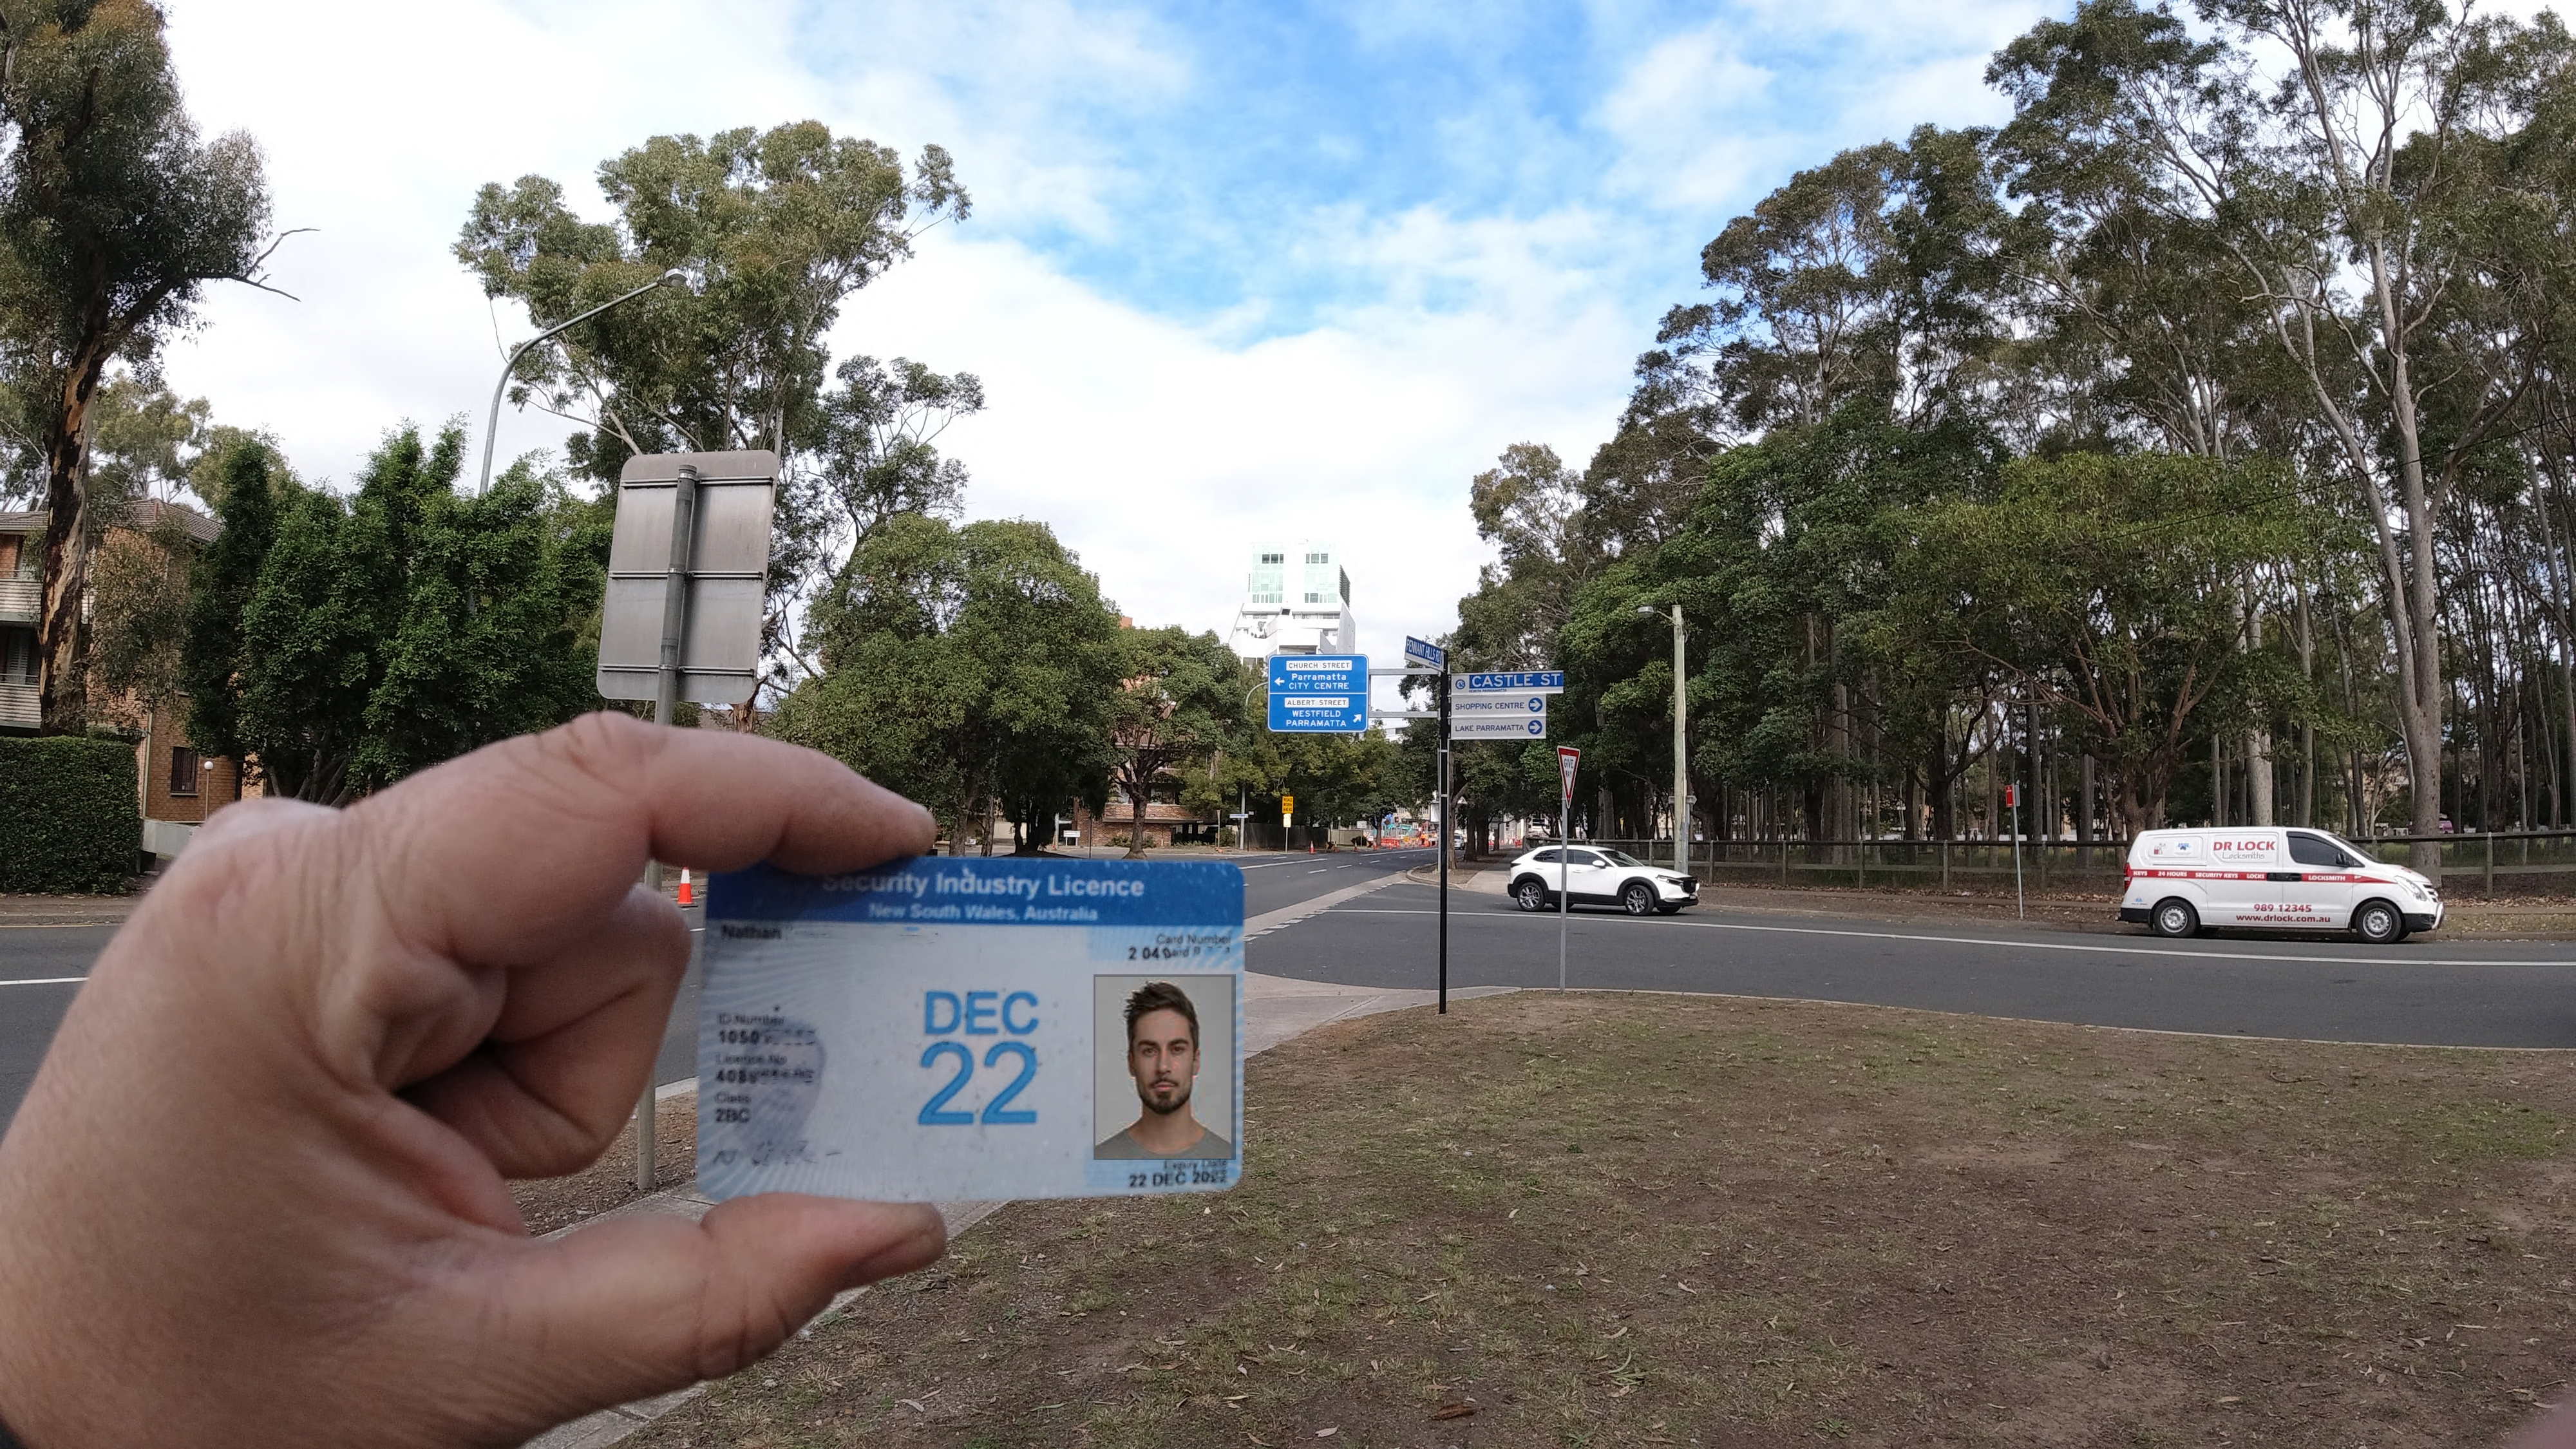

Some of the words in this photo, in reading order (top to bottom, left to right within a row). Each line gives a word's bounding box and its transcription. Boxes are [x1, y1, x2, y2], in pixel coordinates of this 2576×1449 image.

[1406, 638, 1425, 657] PENNANT
[1425, 645, 1435, 661] HILLS
[1472, 674, 1533, 688] CASTLE
[1540, 674, 1560, 686] ST
[1564, 758, 1574, 769] GIVE
[2213, 841, 2232, 851] DR
[2237, 841, 2276, 851] LOCK
[822, 871, 928, 898] Security
[936, 873, 1041, 900] Industry
[1048, 875, 1145, 896] Licence
[869, 903, 905, 917] New
[911, 903, 961, 918] South
[1023, 904, 1099, 921] Australia
[2254, 904, 2274, 912] 989
[2278, 904, 2312, 913] 12345
[2236, 913, 2331, 923] www.drlock.com.au
[721, 924, 781, 939] Nathan
[1157, 933, 1184, 944] Card
[1187, 933, 1231, 944] Number
[719, 1013, 732, 1025] ID
[735, 1014, 784, 1025] Number
[925, 990, 1039, 1035] DEC
[918, 1041, 1037, 1125] 22
[714, 1091, 751, 1104] Class
[1130, 1174, 1146, 1188] 22
[1153, 1171, 1186, 1186] DEC
